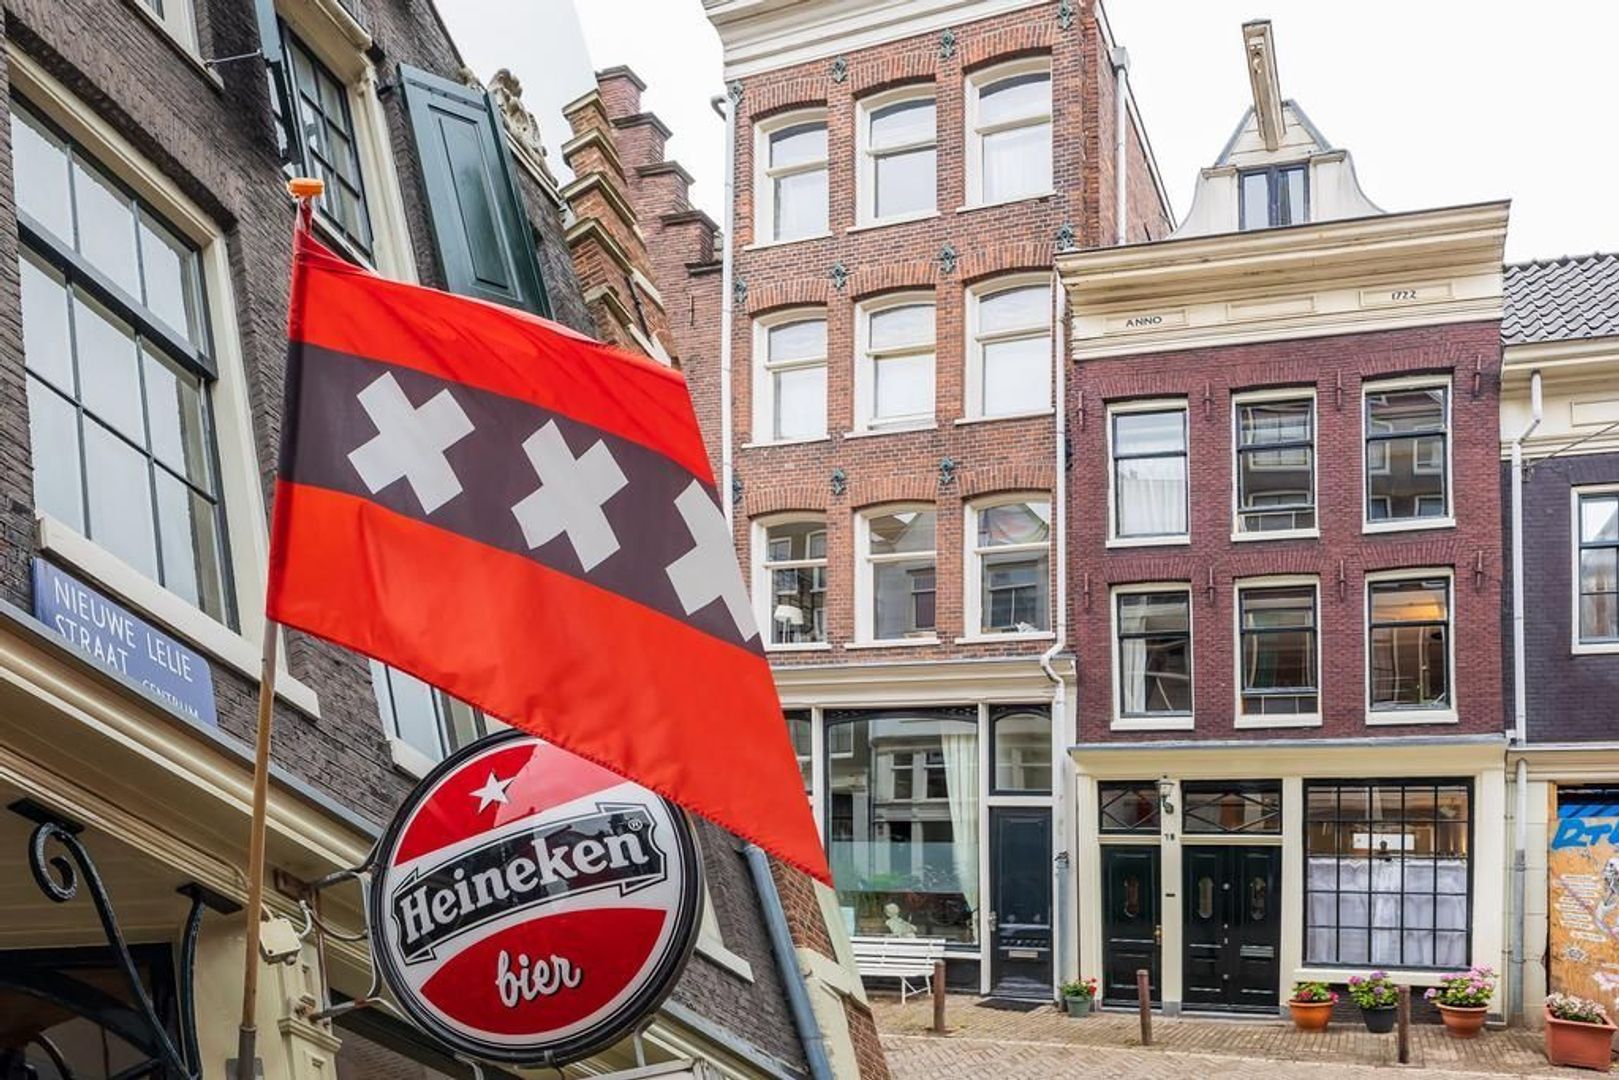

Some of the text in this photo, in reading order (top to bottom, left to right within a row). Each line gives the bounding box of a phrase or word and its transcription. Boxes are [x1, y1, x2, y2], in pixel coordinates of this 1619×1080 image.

[1126, 289, 1417, 328] ANNO 1722
[54, 576, 193, 683] NIEUWE LELIE
[55, 614, 128, 676] STRAAT
[399, 833, 650, 945] Heineken
[495, 950, 582, 1008] bier
